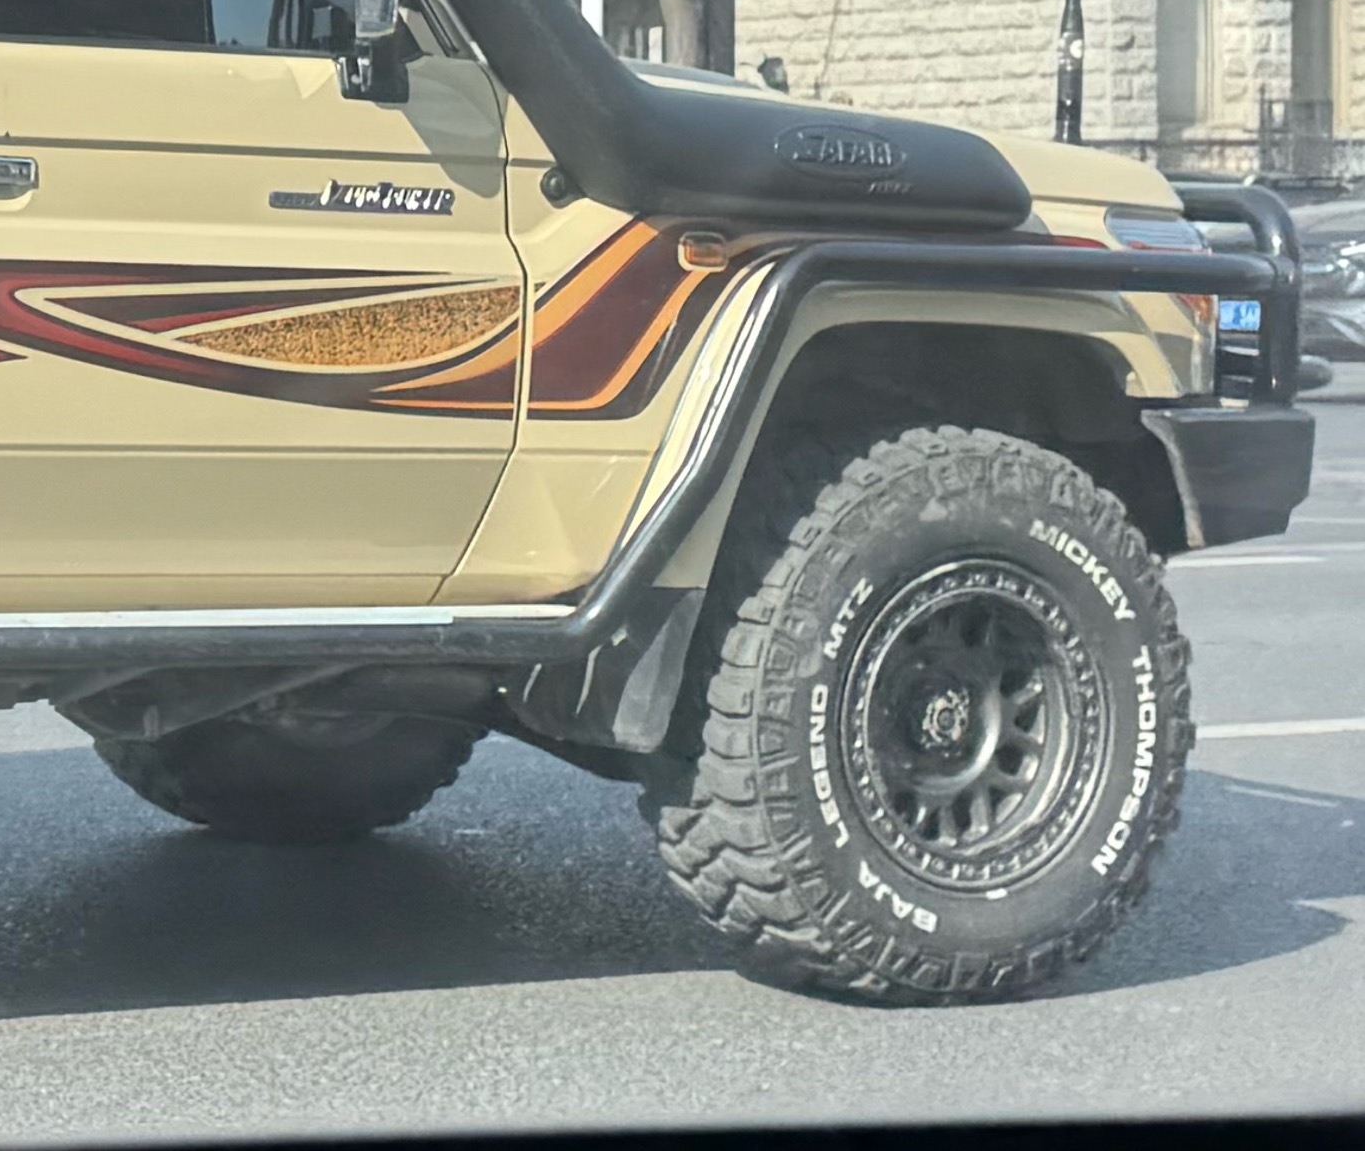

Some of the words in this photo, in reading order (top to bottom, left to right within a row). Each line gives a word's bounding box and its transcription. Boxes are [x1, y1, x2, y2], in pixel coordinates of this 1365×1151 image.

[824, 575, 874, 661] MTZ
[1027, 518, 1136, 624] MICKEY
[1090, 644, 1159, 878] THOMPSON
[807, 682, 850, 850] LEGEND
[858, 858, 940, 935] BAJA
